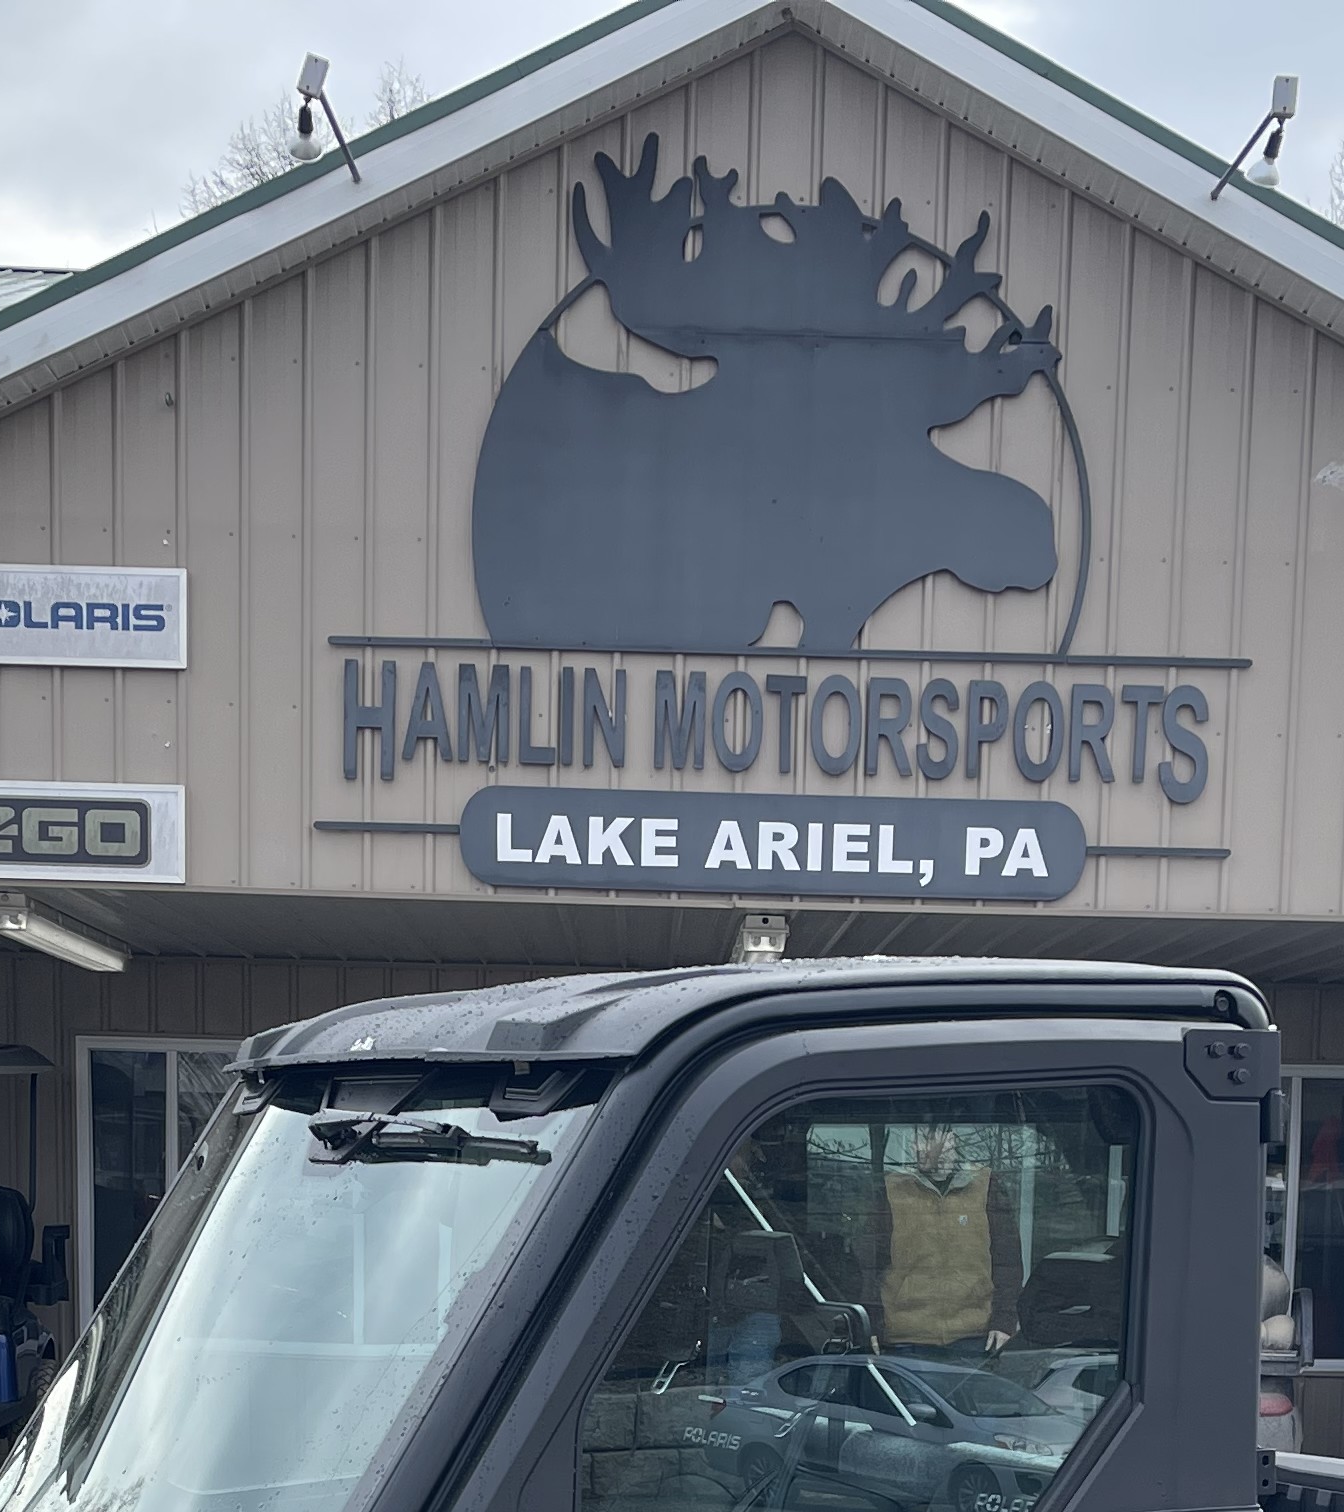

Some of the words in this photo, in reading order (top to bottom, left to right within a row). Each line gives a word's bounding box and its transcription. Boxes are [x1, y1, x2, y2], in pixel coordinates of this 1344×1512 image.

[343, 657, 628, 781] HAMLIN
[655, 668, 1210, 805] MOTORSPORTS
[495, 813, 680, 869] LAKE
[704, 820, 935, 887] ARIEL,
[964, 826, 1049, 878] PA
[683, 1427, 741, 1451] POLARIS
